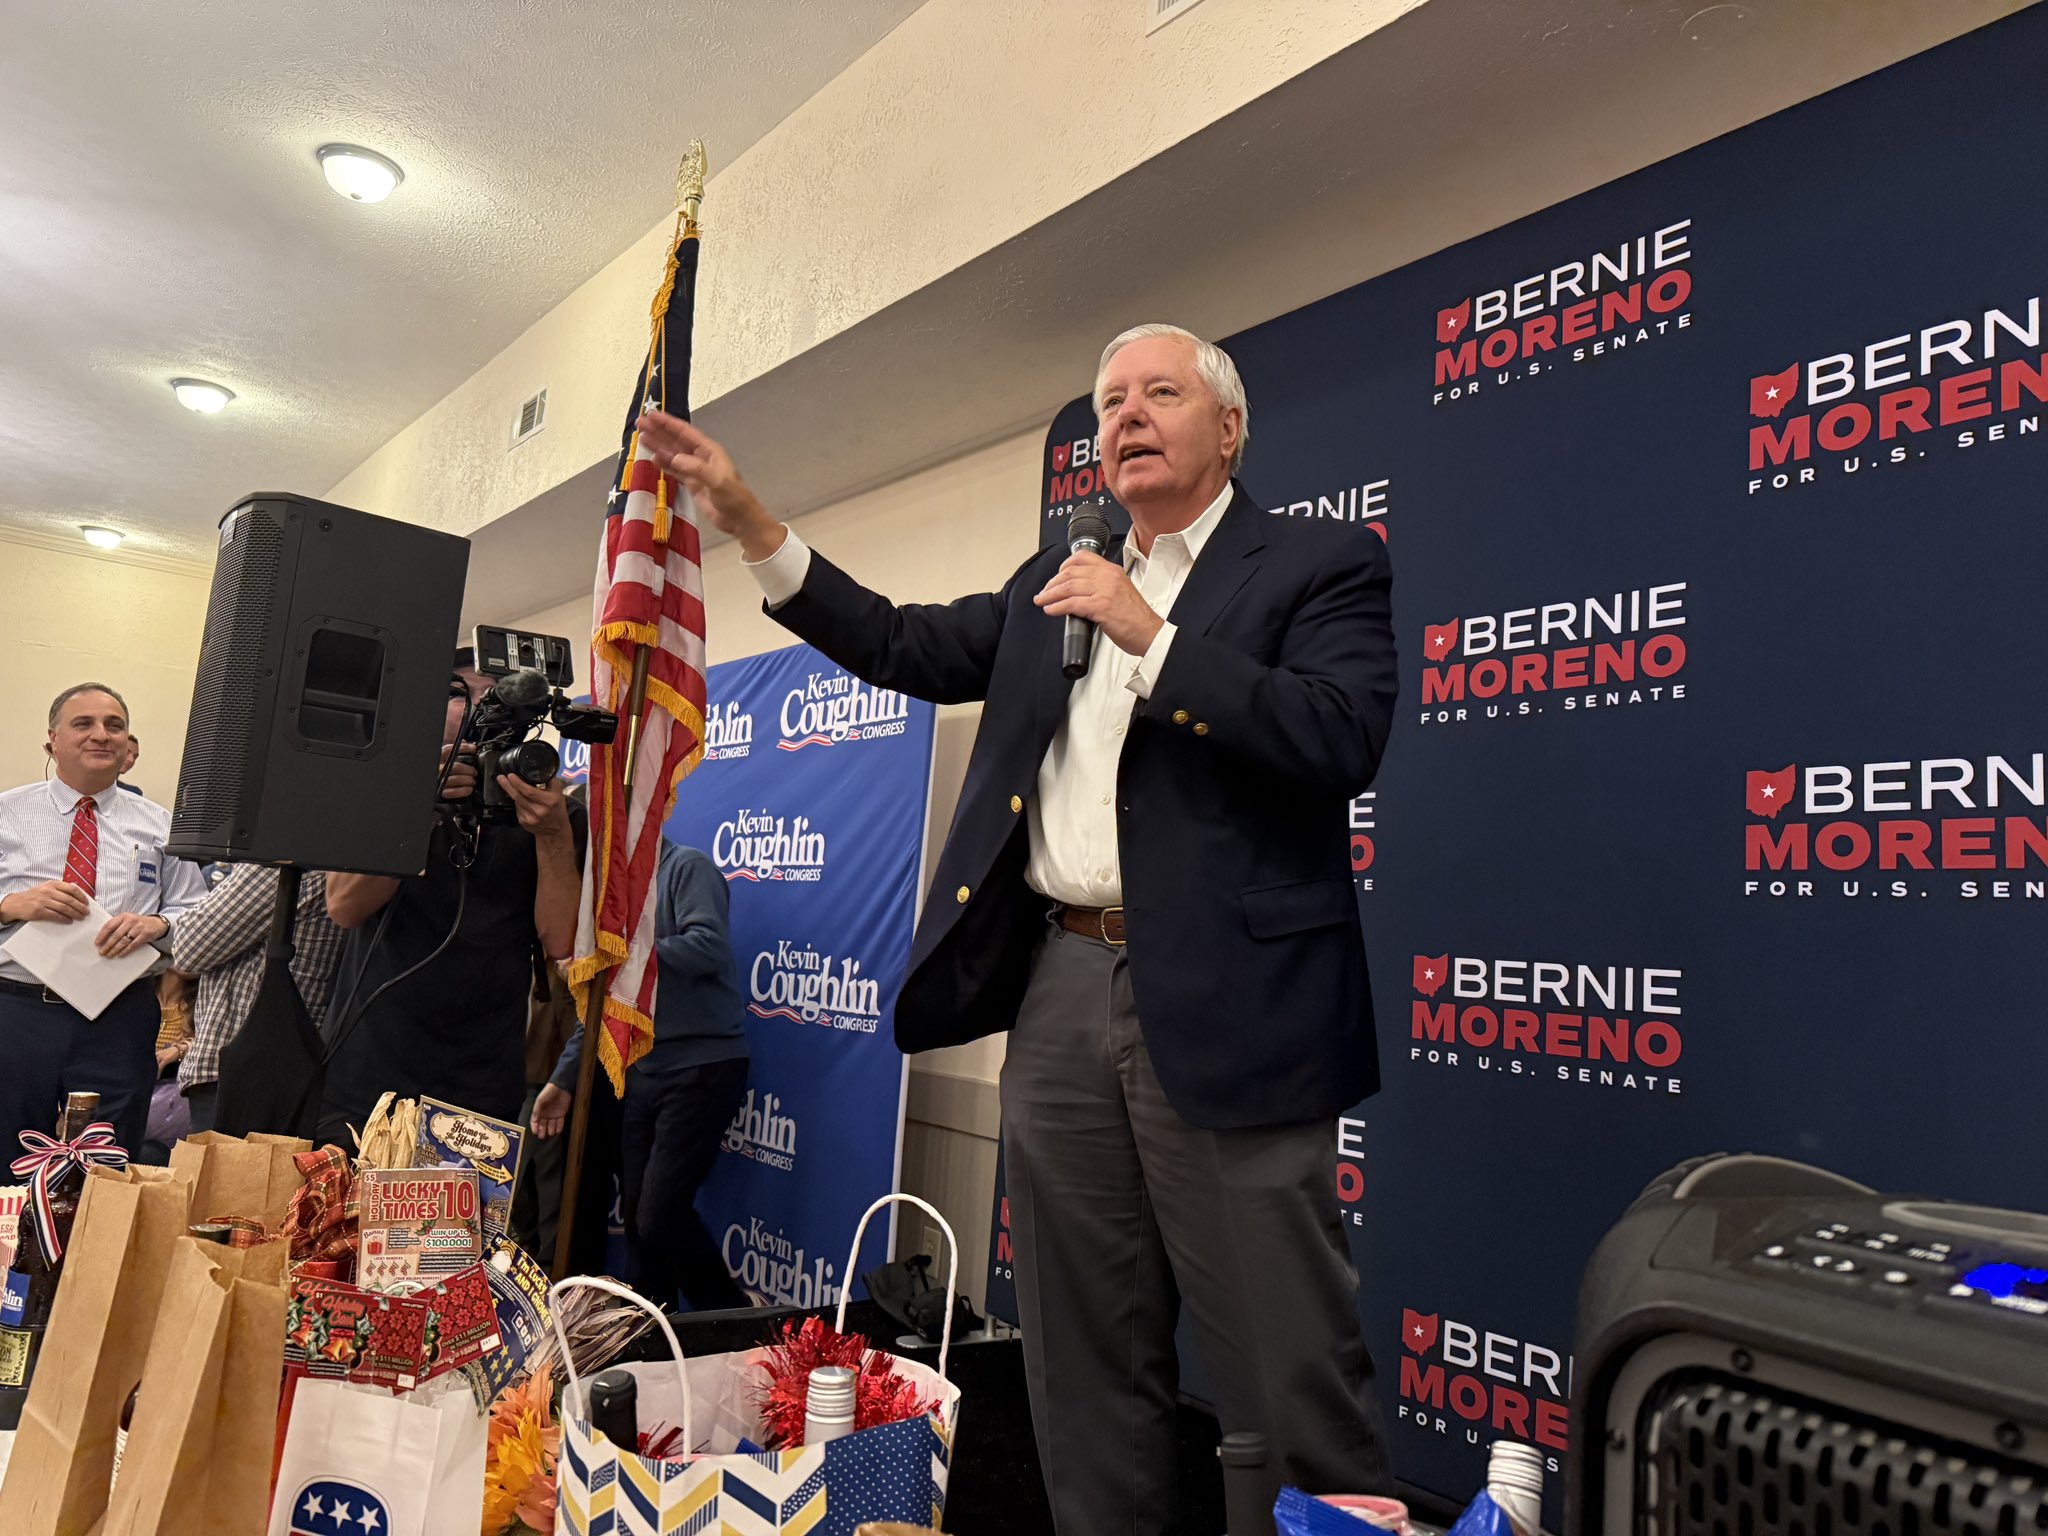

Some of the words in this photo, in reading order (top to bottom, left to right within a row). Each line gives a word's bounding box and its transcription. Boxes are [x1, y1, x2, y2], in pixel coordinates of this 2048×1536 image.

[1473, 218, 1693, 333] BERNIE
[1434, 269, 1693, 386] MORENO
[1433, 380, 1479, 405] FOR
[1497, 361, 1552, 385] U.S.
[1572, 313, 1693, 362] SENATE
[1807, 297, 2041, 406] BERN
[1748, 467, 1816, 495] FOR
[1844, 447, 1925, 473] U.S.
[1957, 416, 2040, 448] SEN
[1048, 505, 1073, 518] FOR
[1463, 582, 1687, 657] BERNIE
[806, 669, 849, 701] Kevin
[1421, 633, 1687, 705] MORENO
[1420, 709, 1467, 725] FOR
[1486, 701, 1543, 718] U.S.
[1565, 684, 1687, 710] SENATE
[862, 720, 906, 740] CONGRESS
[719, 745, 750, 760] CONGRESS
[1805, 753, 2045, 814] BERN
[736, 808, 774, 834] Kevin
[713, 816, 825, 878] Coughlin
[784, 868, 822, 881] CONGRESS
[1745, 881, 1814, 897] FOR
[1843, 881, 1928, 898] U.S.
[1961, 881, 2046, 899] SEN
[777, 940, 820, 971] Kevin
[750, 951, 881, 1024] Coughlin
[1453, 957, 1683, 1016] BERNIE
[833, 1015, 878, 1033] CONGRESS
[1411, 1000, 1682, 1068] MORENO
[1411, 1048, 1459, 1066] FOR
[1478, 1055, 1536, 1075] U.S.
[1557, 1066, 1682, 1094] SENATE
[451, 1120, 479, 1136] Home
[454, 1134, 492, 1153] Holidays
[755, 1147, 794, 1172] CONGRESS
[365, 1173, 376, 1182] $5
[371, 1182, 380, 1220] HOLIDAY
[382, 1182, 441, 1200] LUCKY
[443, 1181, 474, 1219] 10
[383, 1202, 438, 1219] TIMES
[748, 1216, 793, 1262] Kevin
[517, 1257, 530, 1272] I'm
[995, 1267, 1012, 1279] FO
[515, 1273, 530, 1291] AND
[531, 1294, 549, 1318] GNOME
[467, 1321, 492, 1335] MILLION
[1443, 1320, 1574, 1399] BER
[1399, 1405, 1447, 1434] FOR
